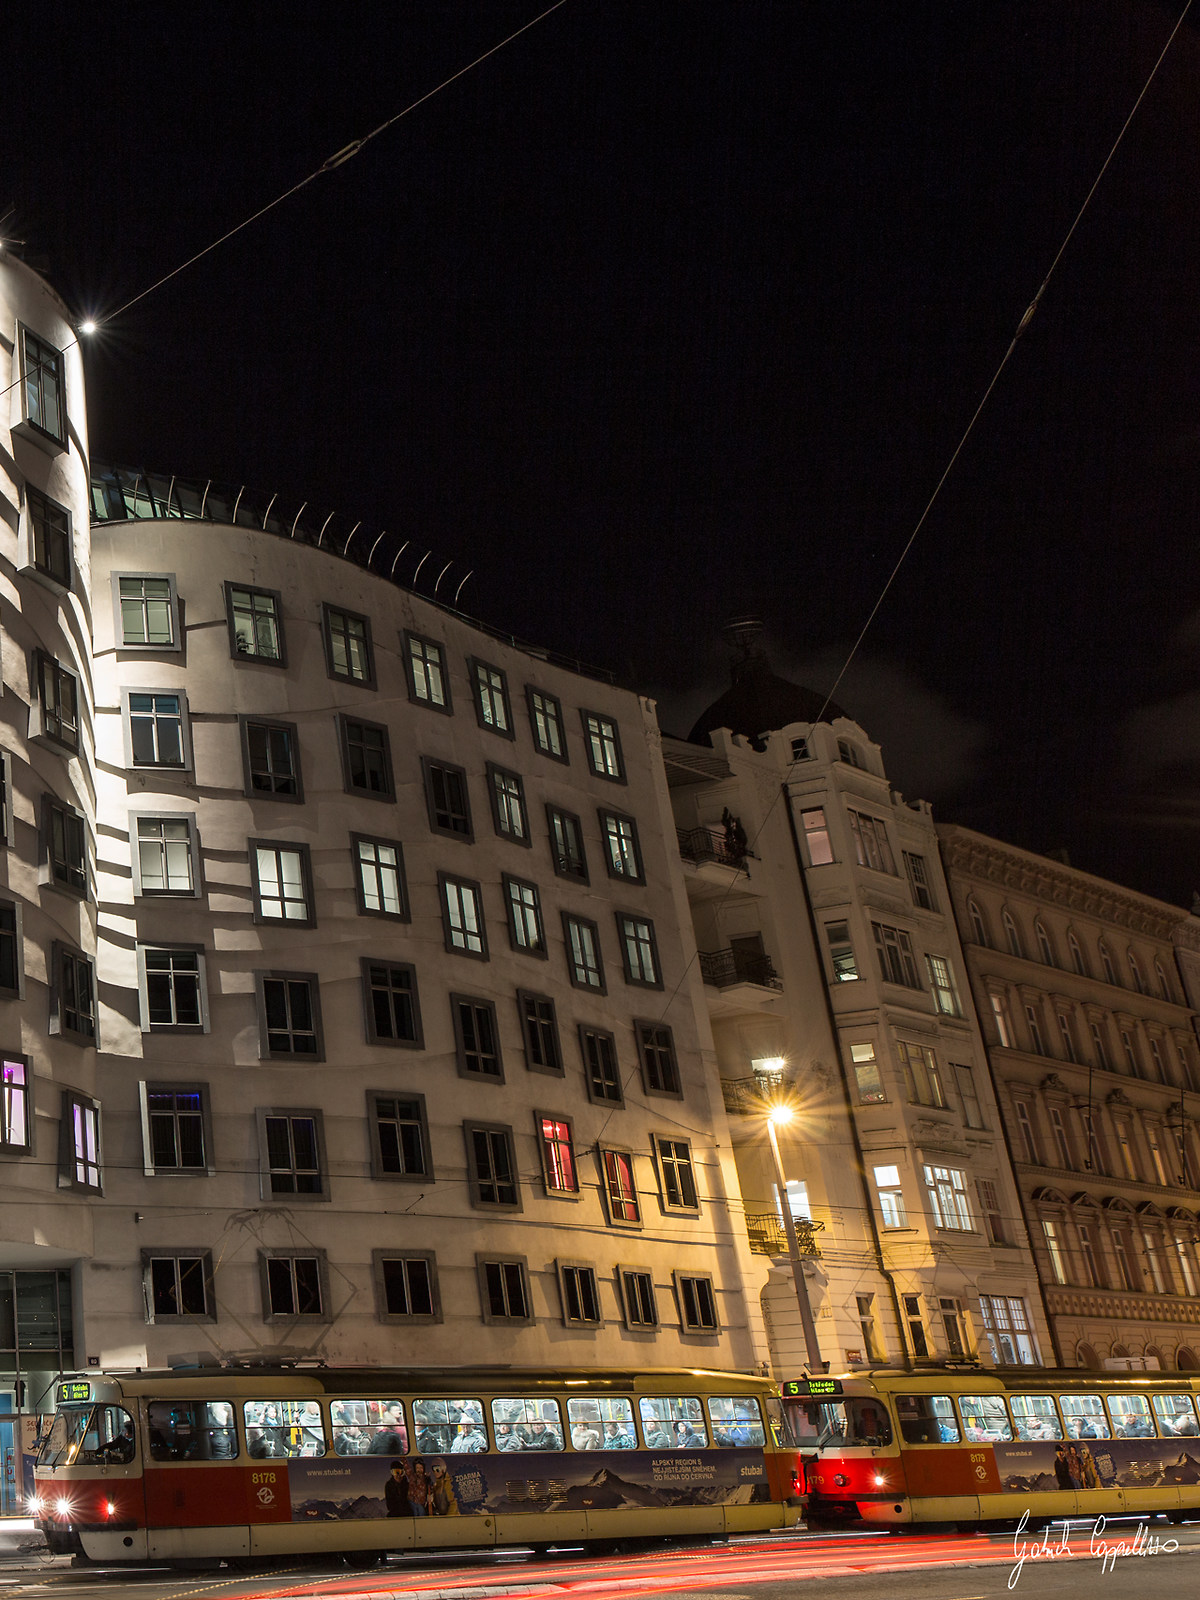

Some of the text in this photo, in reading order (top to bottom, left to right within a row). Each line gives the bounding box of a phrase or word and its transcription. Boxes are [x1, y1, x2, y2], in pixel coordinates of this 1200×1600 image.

[62, 1384, 69, 1400] 5
[789, 1382, 799, 1394] 5
[970, 1453, 986, 1463] 8179
[307, 1468, 352, 1477] www.stubai.at
[740, 1464, 763, 1476] stubai
[252, 1472, 276, 1484] 8178
[454, 1471, 481, 1483] ZDARMA
